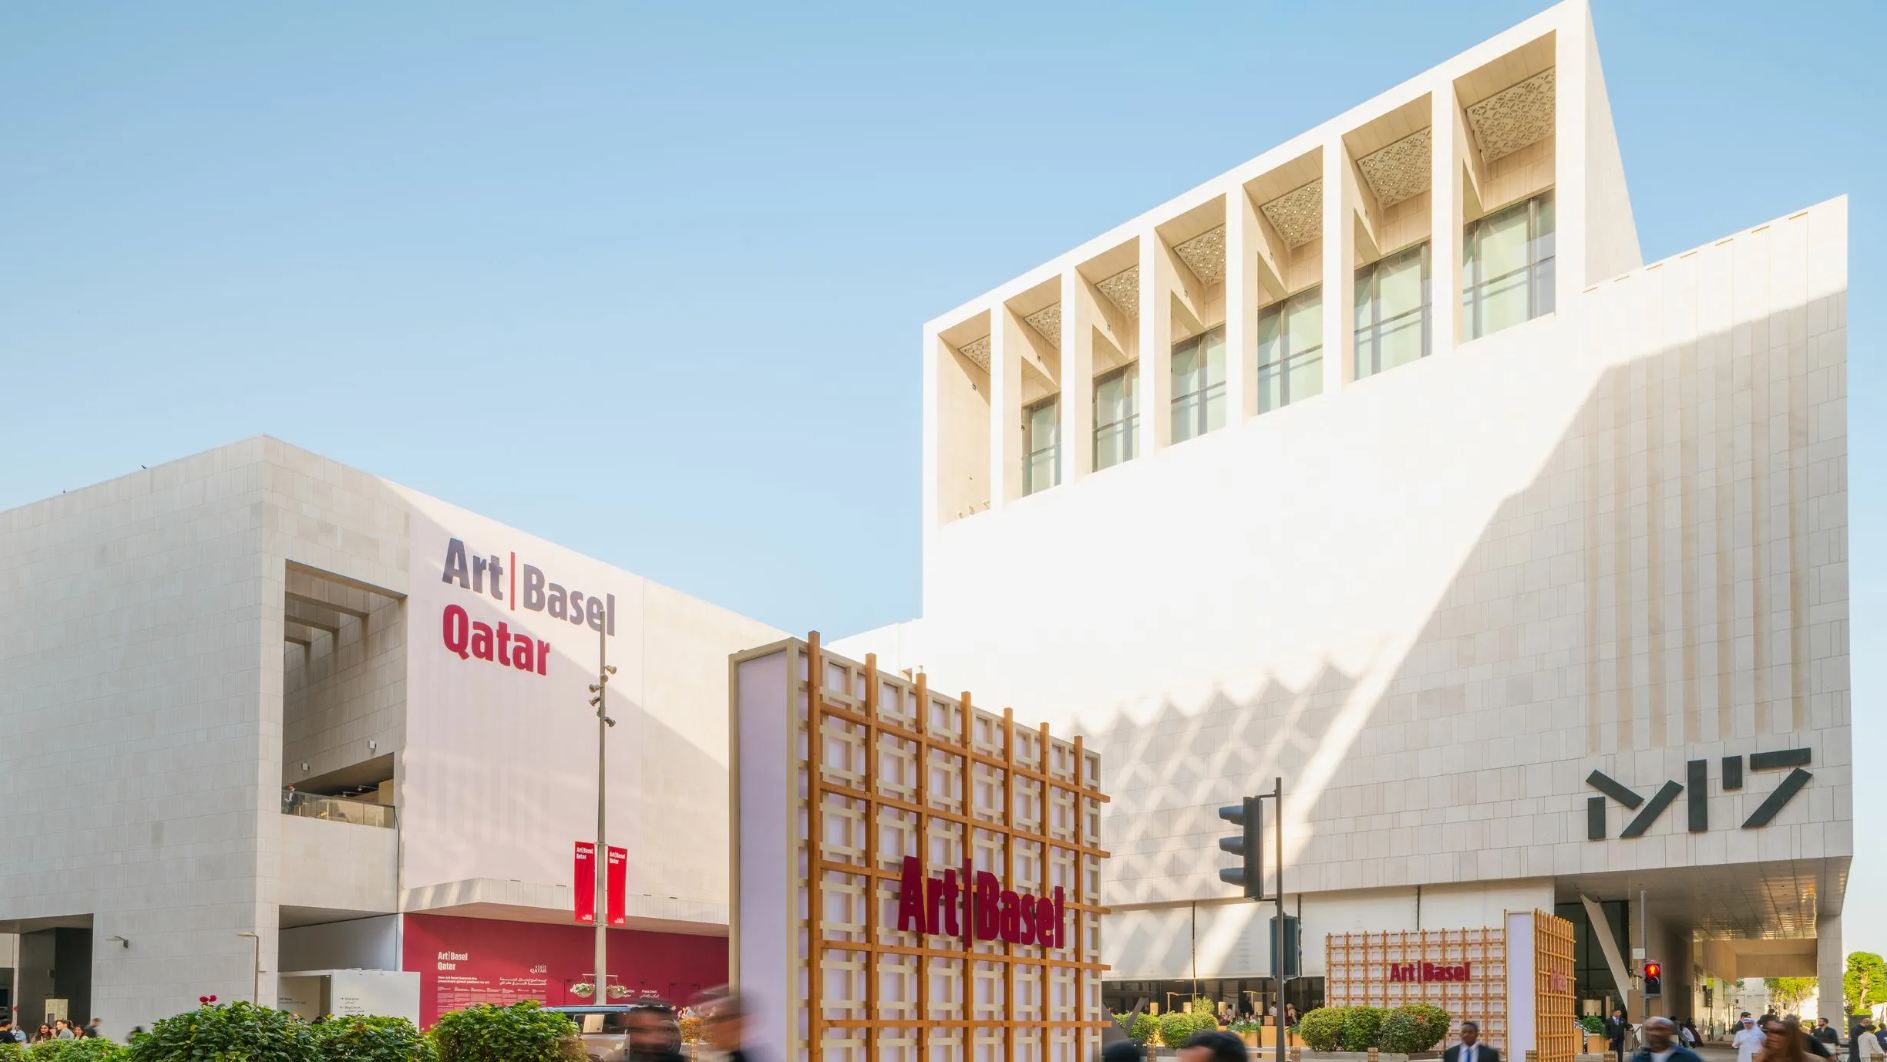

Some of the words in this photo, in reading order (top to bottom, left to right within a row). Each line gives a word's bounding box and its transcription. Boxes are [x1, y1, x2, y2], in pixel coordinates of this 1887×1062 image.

[442, 538, 503, 600] Art
[523, 563, 615, 636] Basel
[443, 604, 550, 676] Qatar
[897, 855, 959, 937] Art
[977, 870, 1064, 949] Basel
[438, 962, 456, 971] Qatar
[1390, 963, 1415, 982] Art
[1423, 962, 1470, 982] Basel
